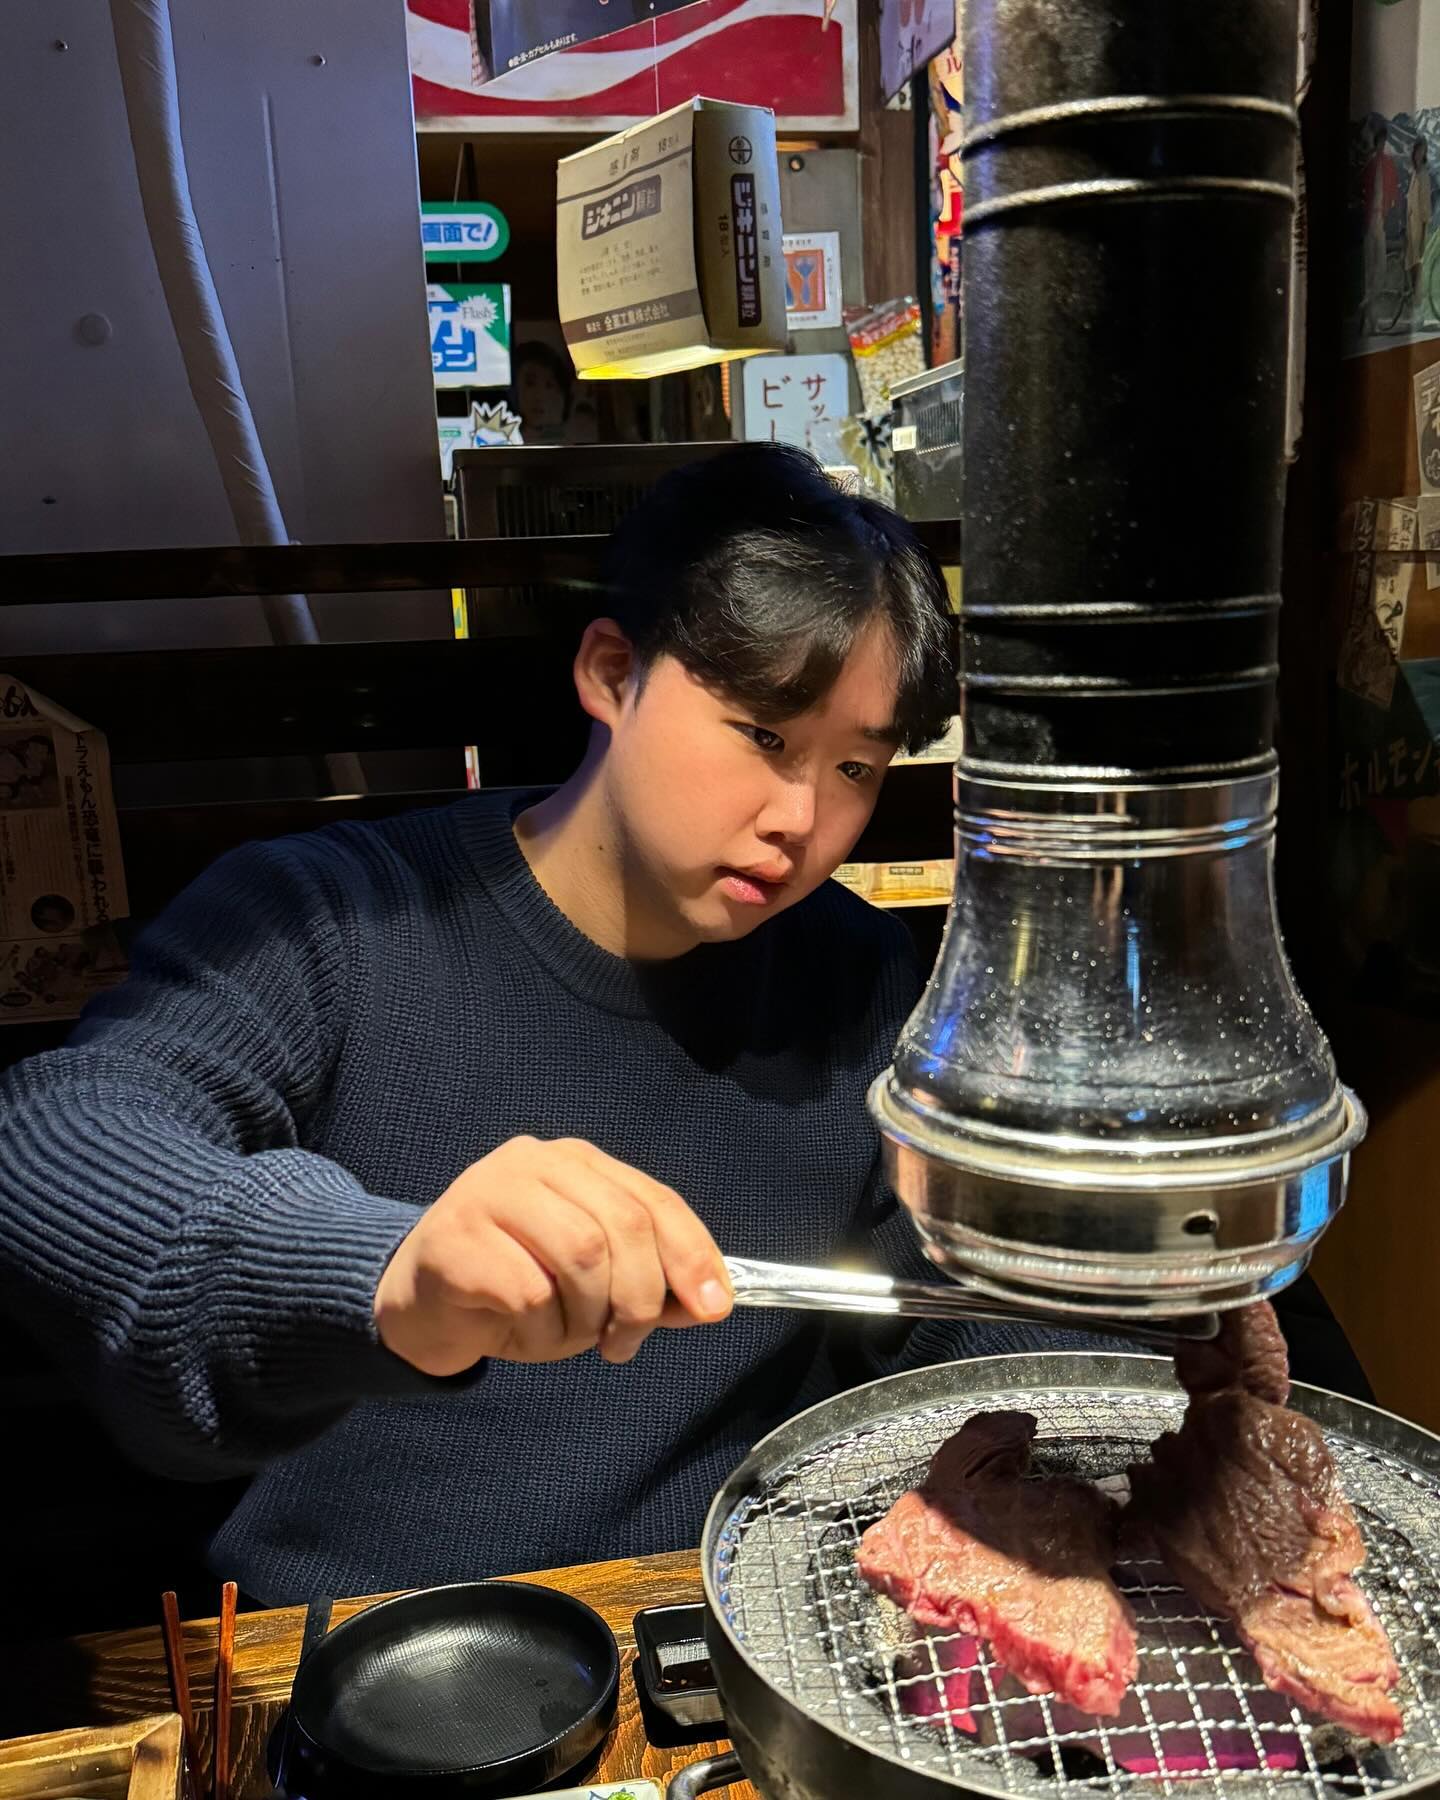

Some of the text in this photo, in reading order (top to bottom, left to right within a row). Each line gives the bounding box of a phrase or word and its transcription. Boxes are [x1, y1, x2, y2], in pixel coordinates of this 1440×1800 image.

[733, 180, 758, 320] ジキニン顆粒
[1337, 738, 1440, 812] ホルモン
